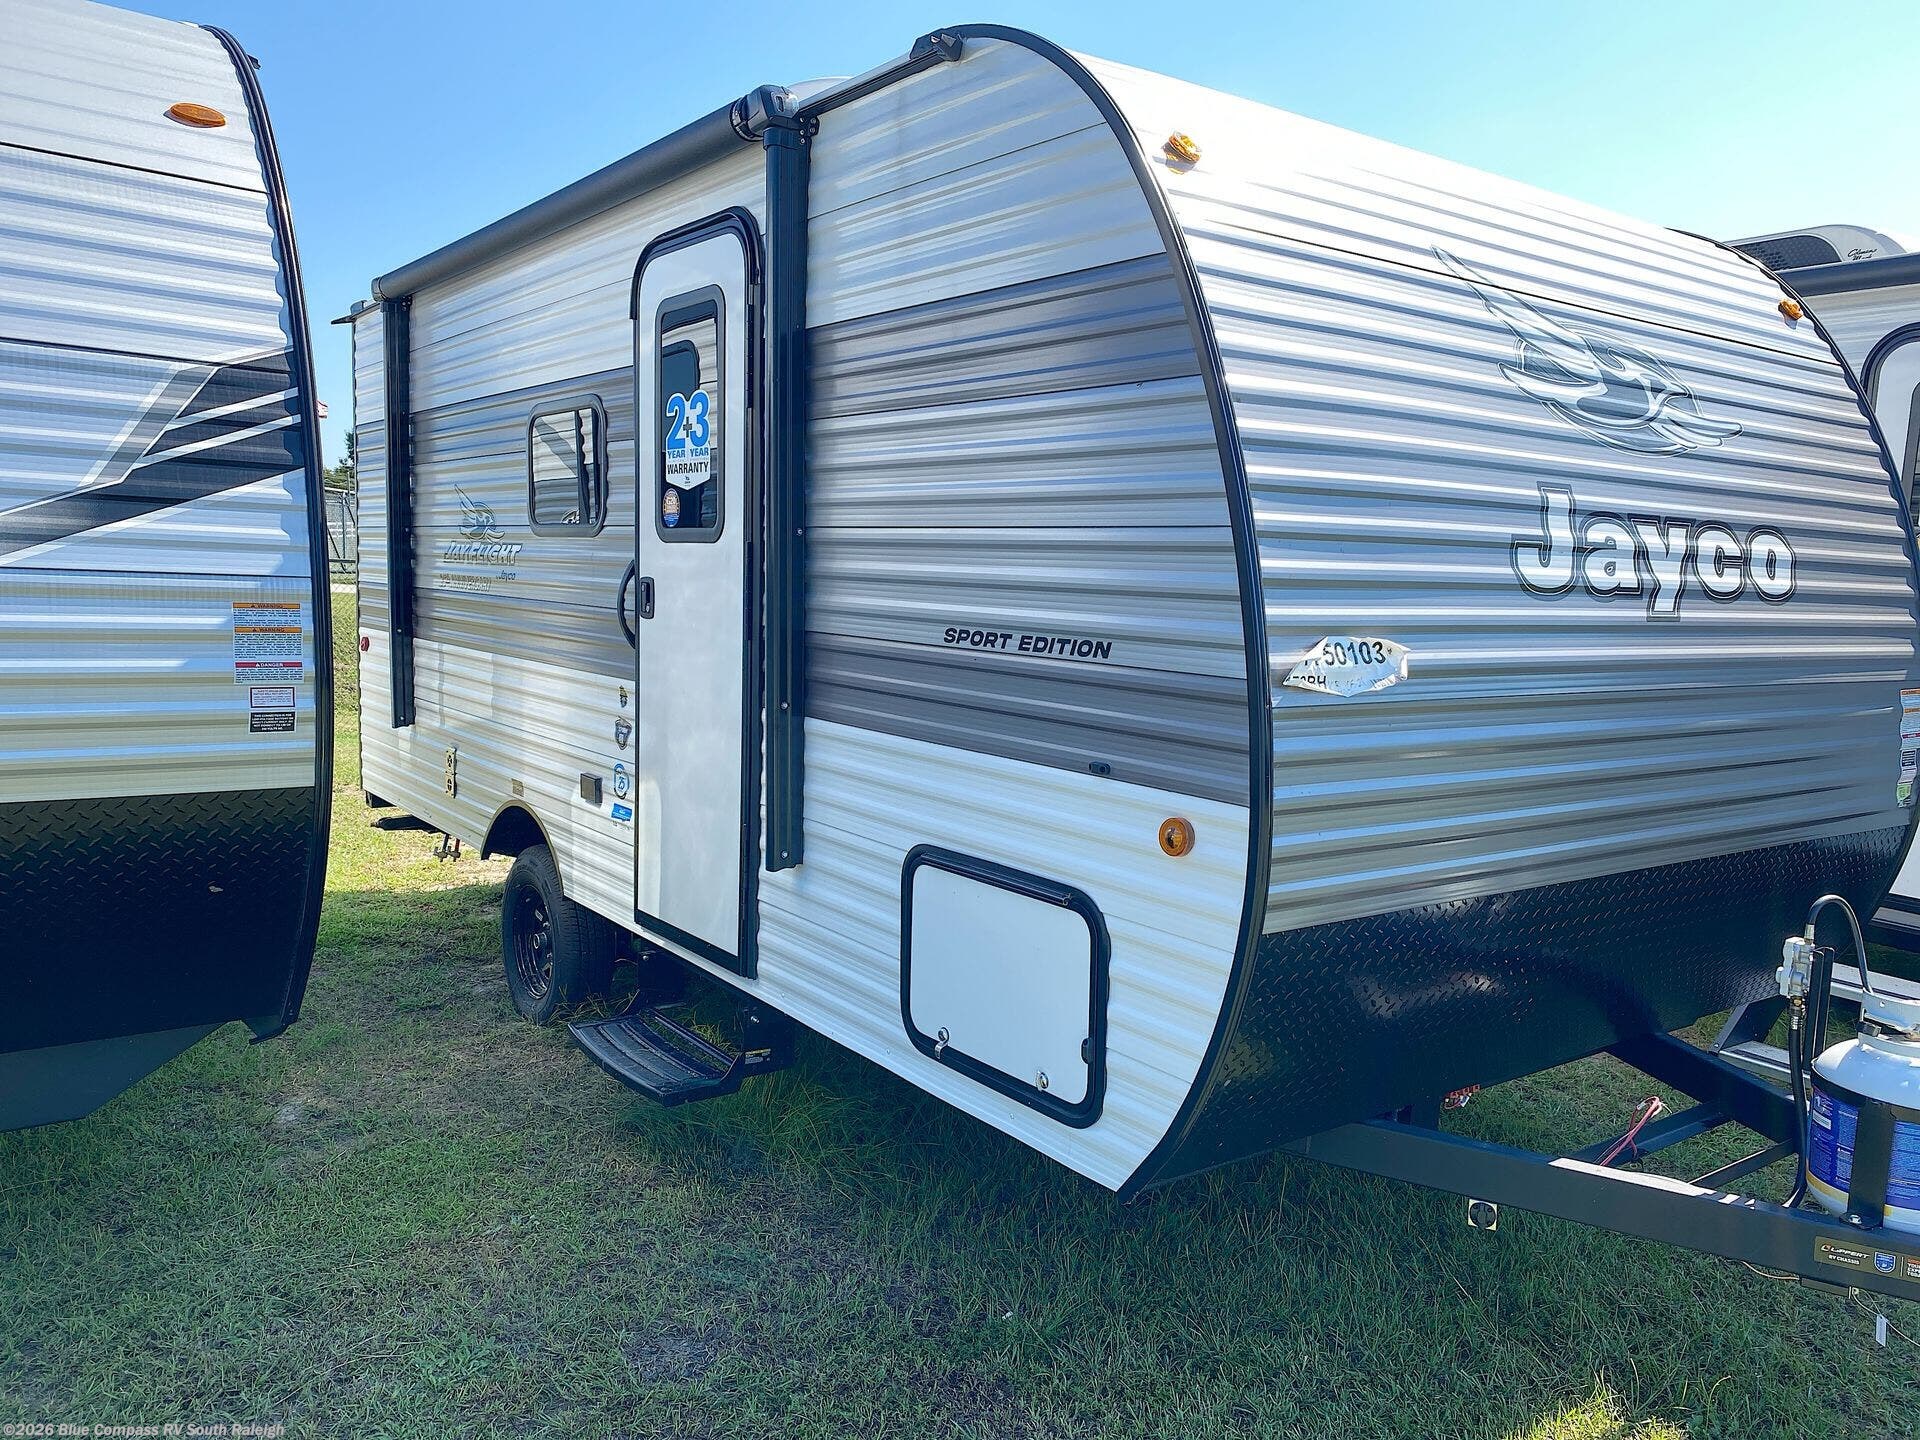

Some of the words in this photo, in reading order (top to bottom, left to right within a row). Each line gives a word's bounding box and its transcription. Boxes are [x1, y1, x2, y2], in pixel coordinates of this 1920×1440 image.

[667, 449, 686, 459] YEAR
[689, 447, 709, 457] YEAR
[667, 462, 709, 475] WARRANTY
[1510, 481, 1797, 622] Jayco
[943, 627, 1013, 650] SPORT
[1017, 634, 1113, 660] EDITION
[1831, 1247, 1869, 1259] LIPPERT
